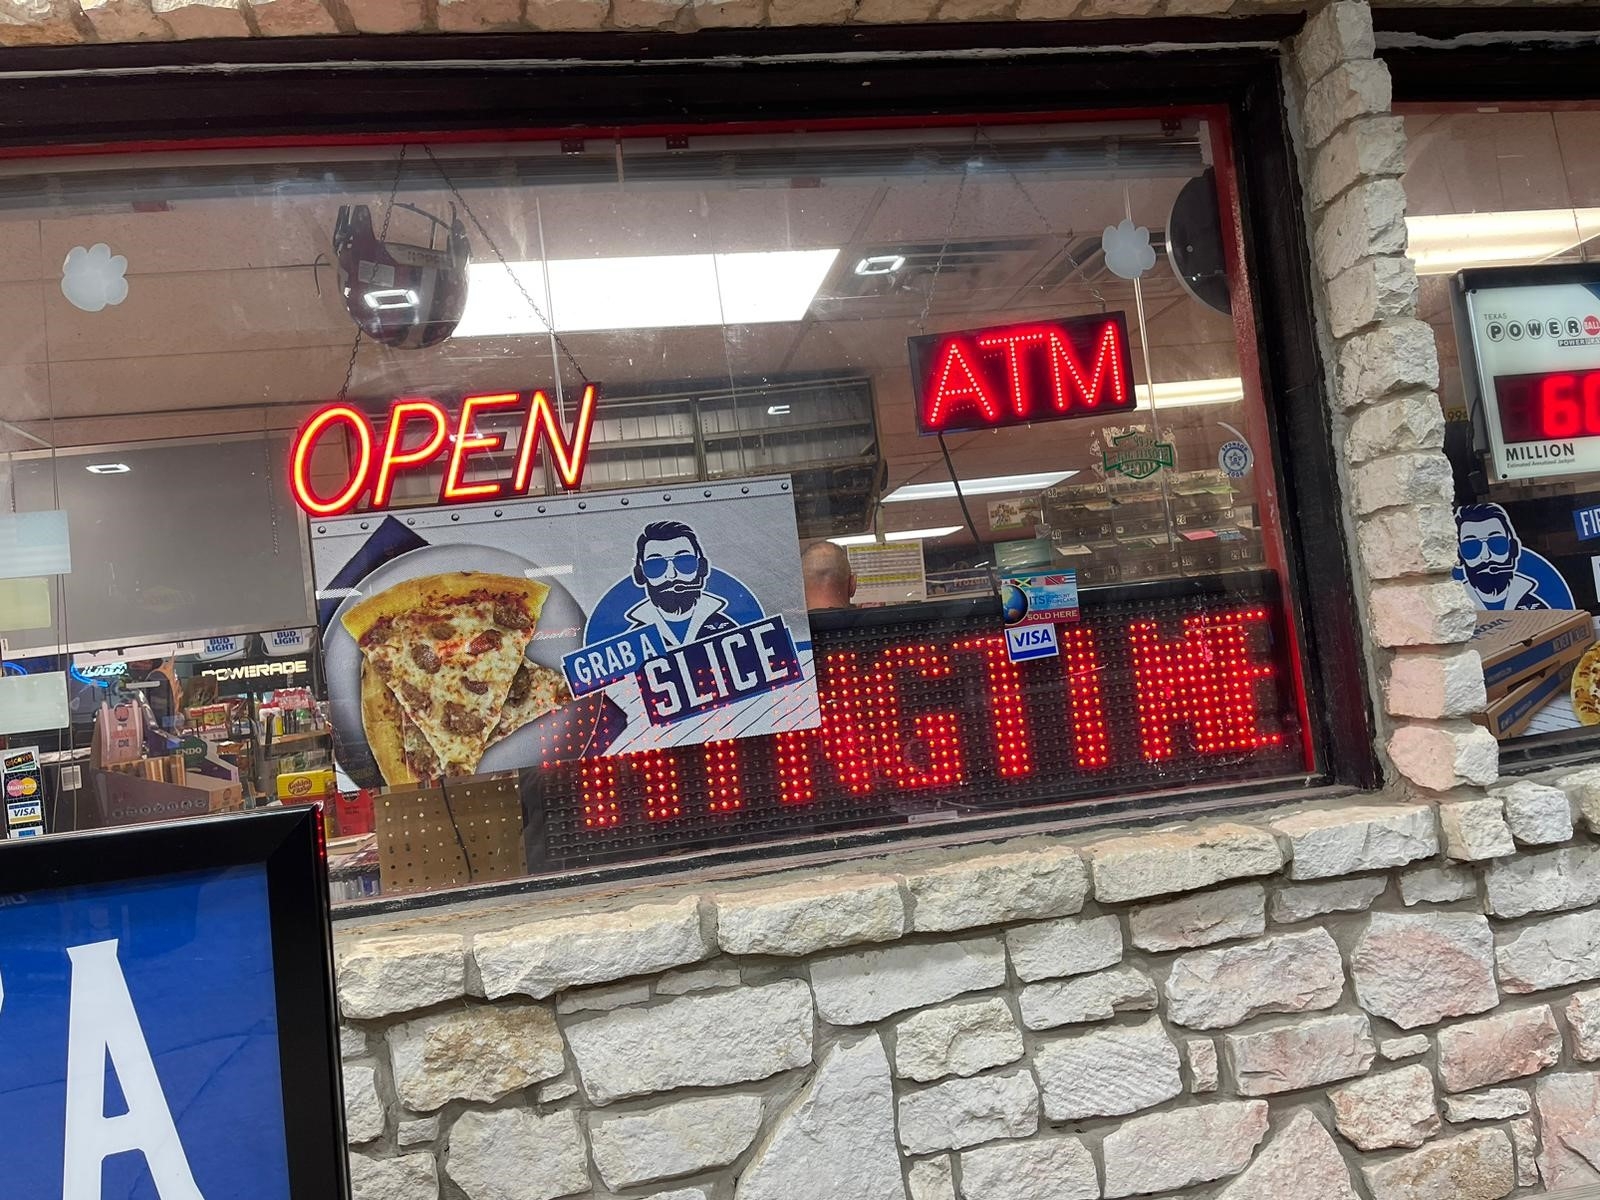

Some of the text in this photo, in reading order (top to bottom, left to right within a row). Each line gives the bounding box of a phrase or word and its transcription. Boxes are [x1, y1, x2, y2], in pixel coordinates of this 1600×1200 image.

[1484, 312, 1507, 321] TEXAS
[926, 322, 1126, 425] ATM
[291, 382, 596, 516] OPEN
[1505, 443, 1574, 461] MILLION
[1029, 595, 1046, 605] ITS
[1027, 609, 1078, 621] SOLD HERE
[276, 630, 296, 639] BUD
[1014, 629, 1052, 647] VISA
[274, 636, 301, 646] LIGHT
[207, 643, 235, 653] LIGHT
[574, 633, 657, 684] GRAB A
[643, 622, 789, 717] SLICE
[14, 807, 36, 817] VISA
